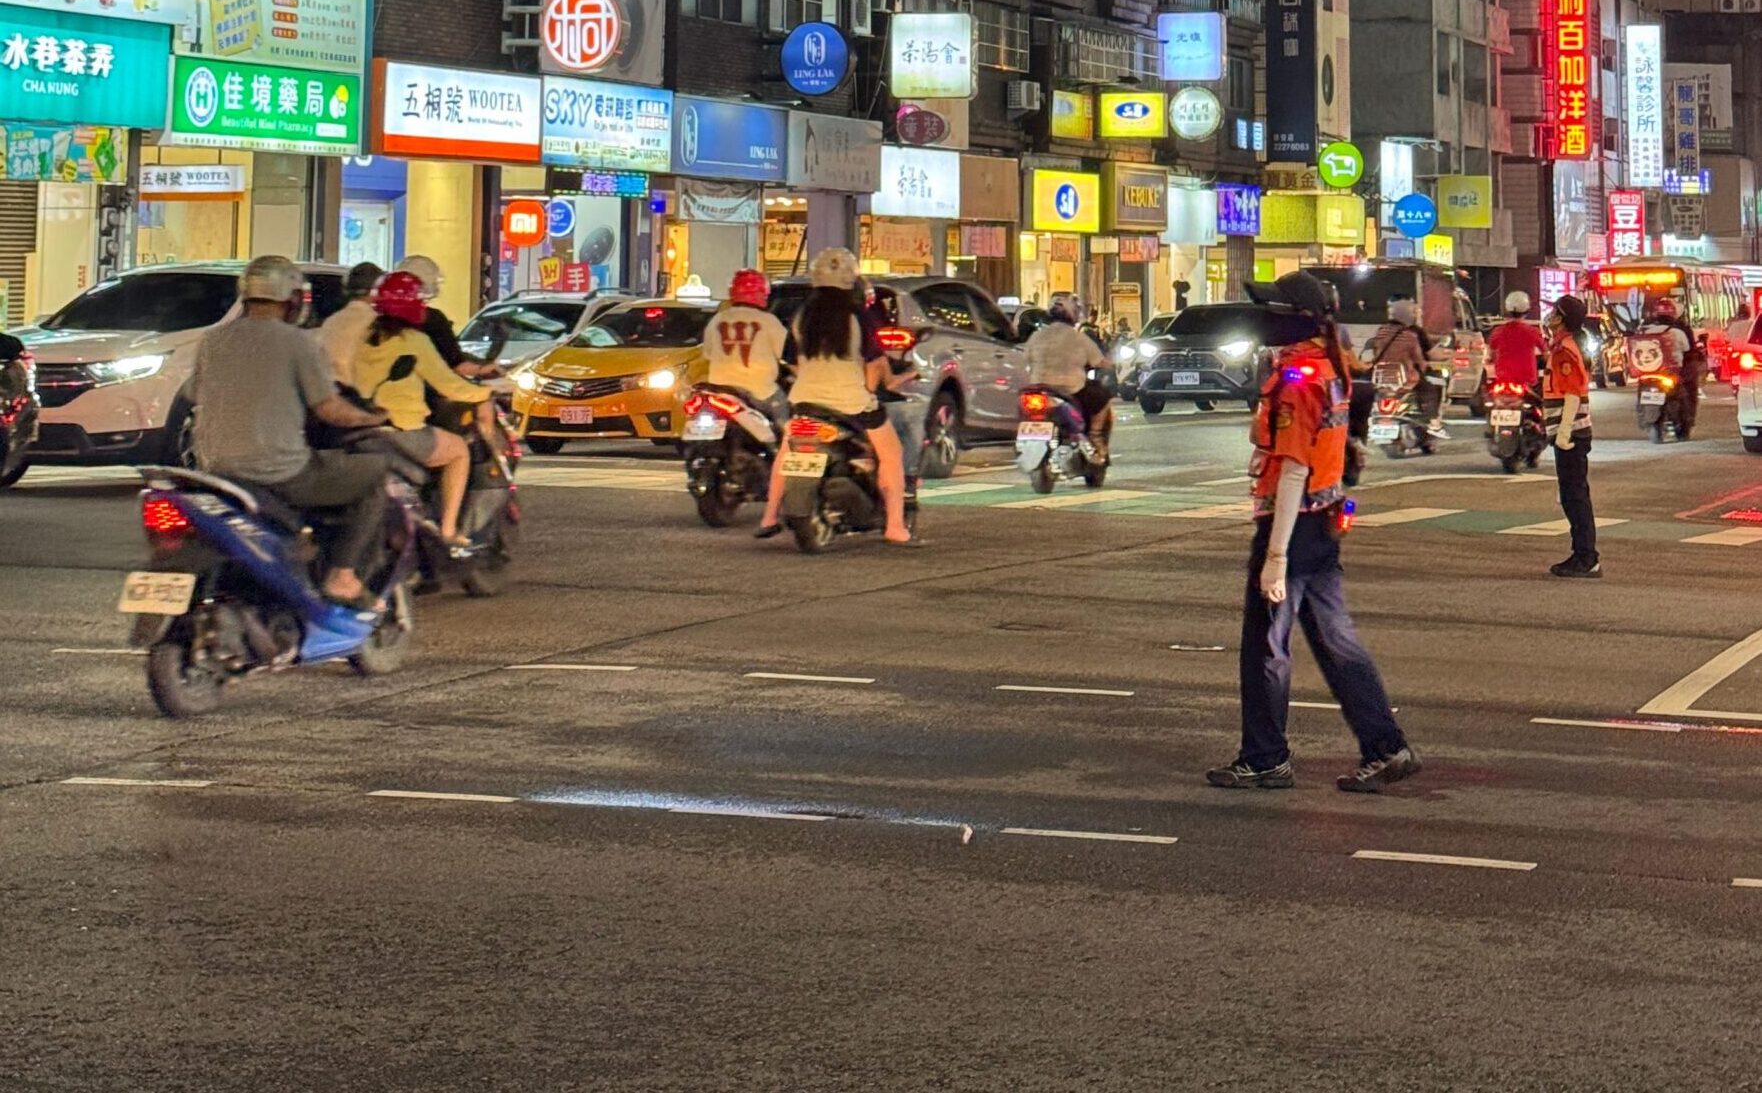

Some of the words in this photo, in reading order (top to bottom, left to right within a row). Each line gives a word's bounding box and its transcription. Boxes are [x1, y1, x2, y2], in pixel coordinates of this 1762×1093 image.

[2, 33, 115, 78] 水巷茶弄
[902, 39, 960, 65] 茶湯會
[794, 69, 815, 78] LING
[23, 79, 46, 93] CHA
[47, 81, 79, 96] NUNG
[222, 71, 324, 117] 佳境藥局
[468, 88, 523, 112] WOOTEA
[545, 88, 593, 127] SKY
[187, 172, 230, 181] WOOTEA
[1123, 186, 1161, 208] KEBUKE
